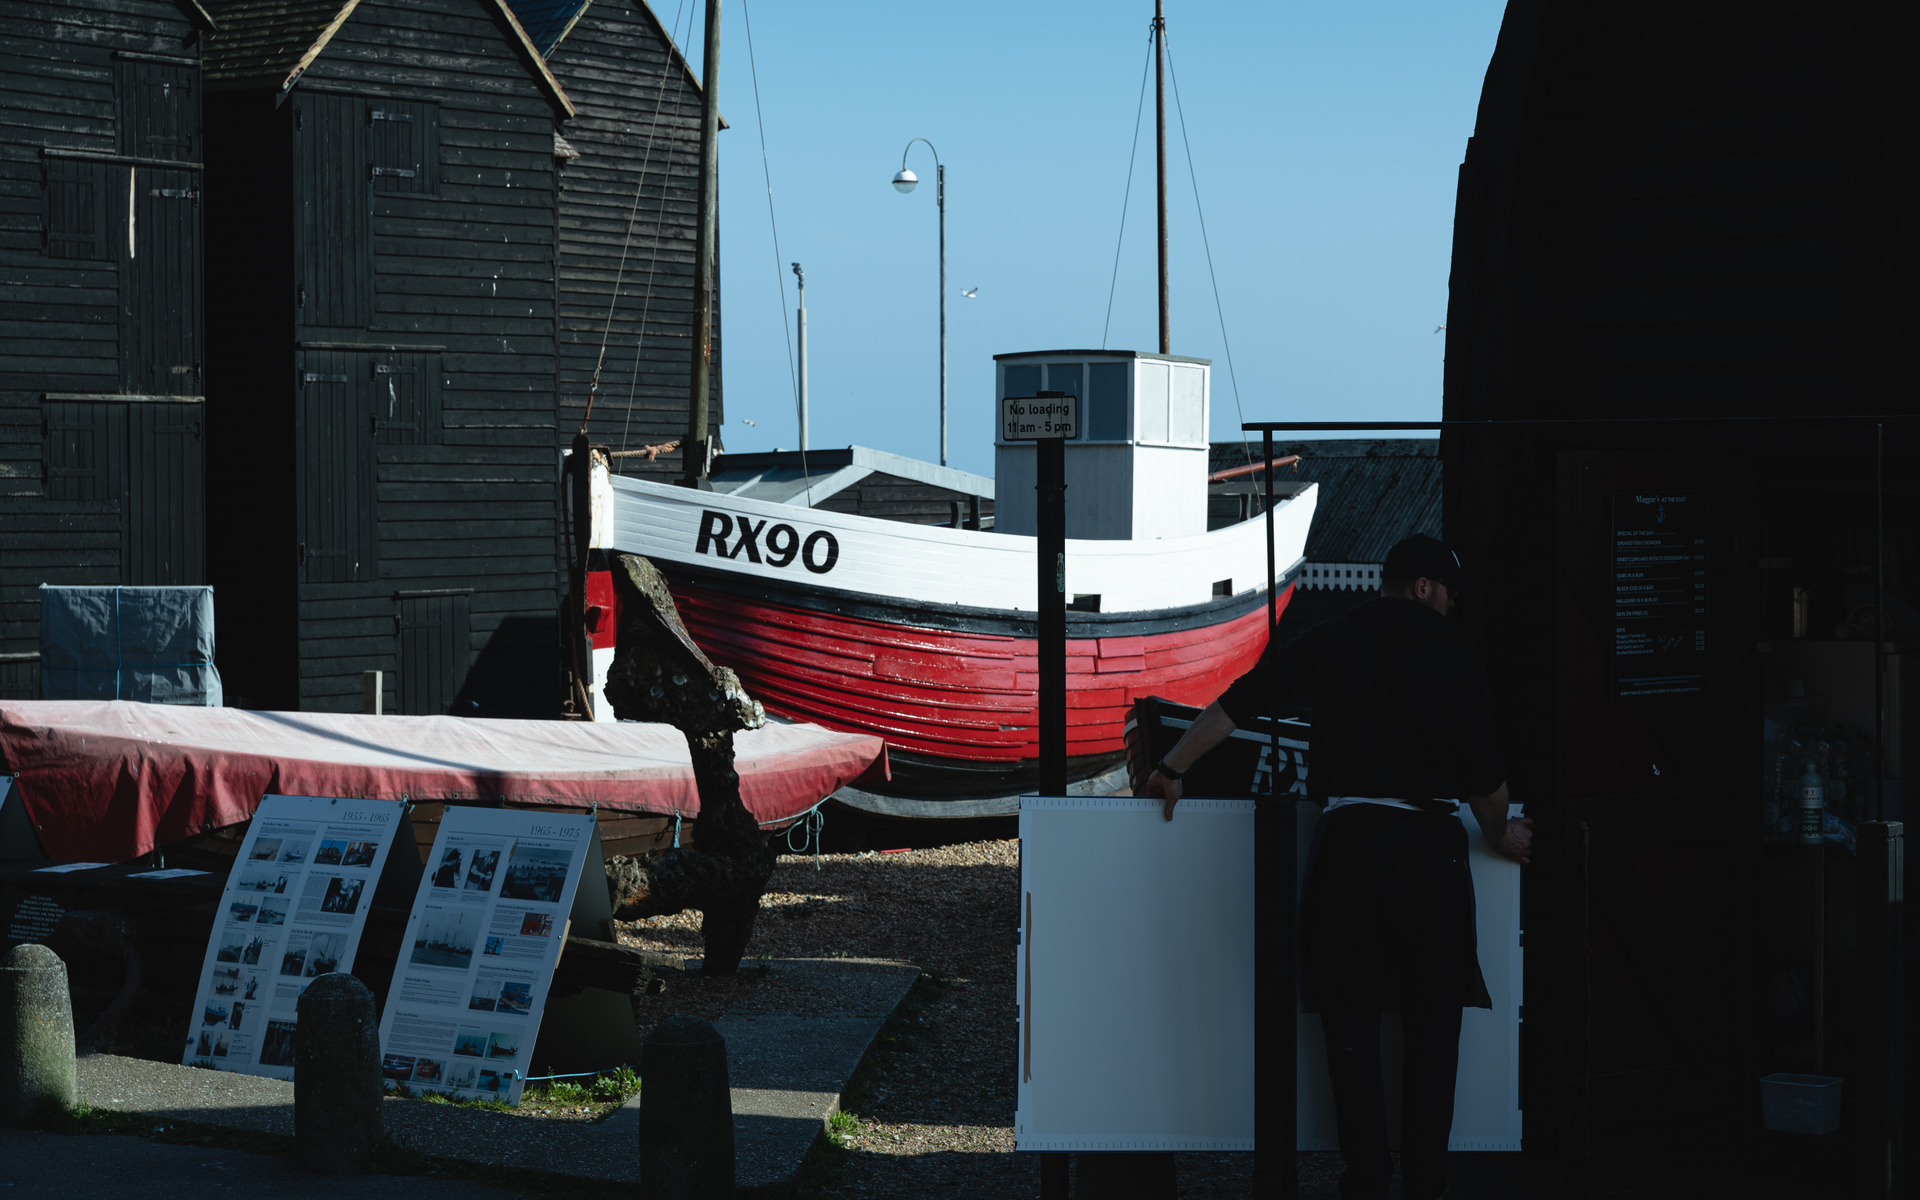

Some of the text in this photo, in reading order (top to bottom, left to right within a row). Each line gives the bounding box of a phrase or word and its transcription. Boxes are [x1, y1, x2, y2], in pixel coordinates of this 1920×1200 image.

[1009, 403, 1070, 416] No loading
[694, 509, 840, 575] RX90
[342, 810, 362, 822] 1955
[369, 812, 391, 823] 1965
[529, 824, 552, 836] 1965
[558, 826, 581, 839] 1975
